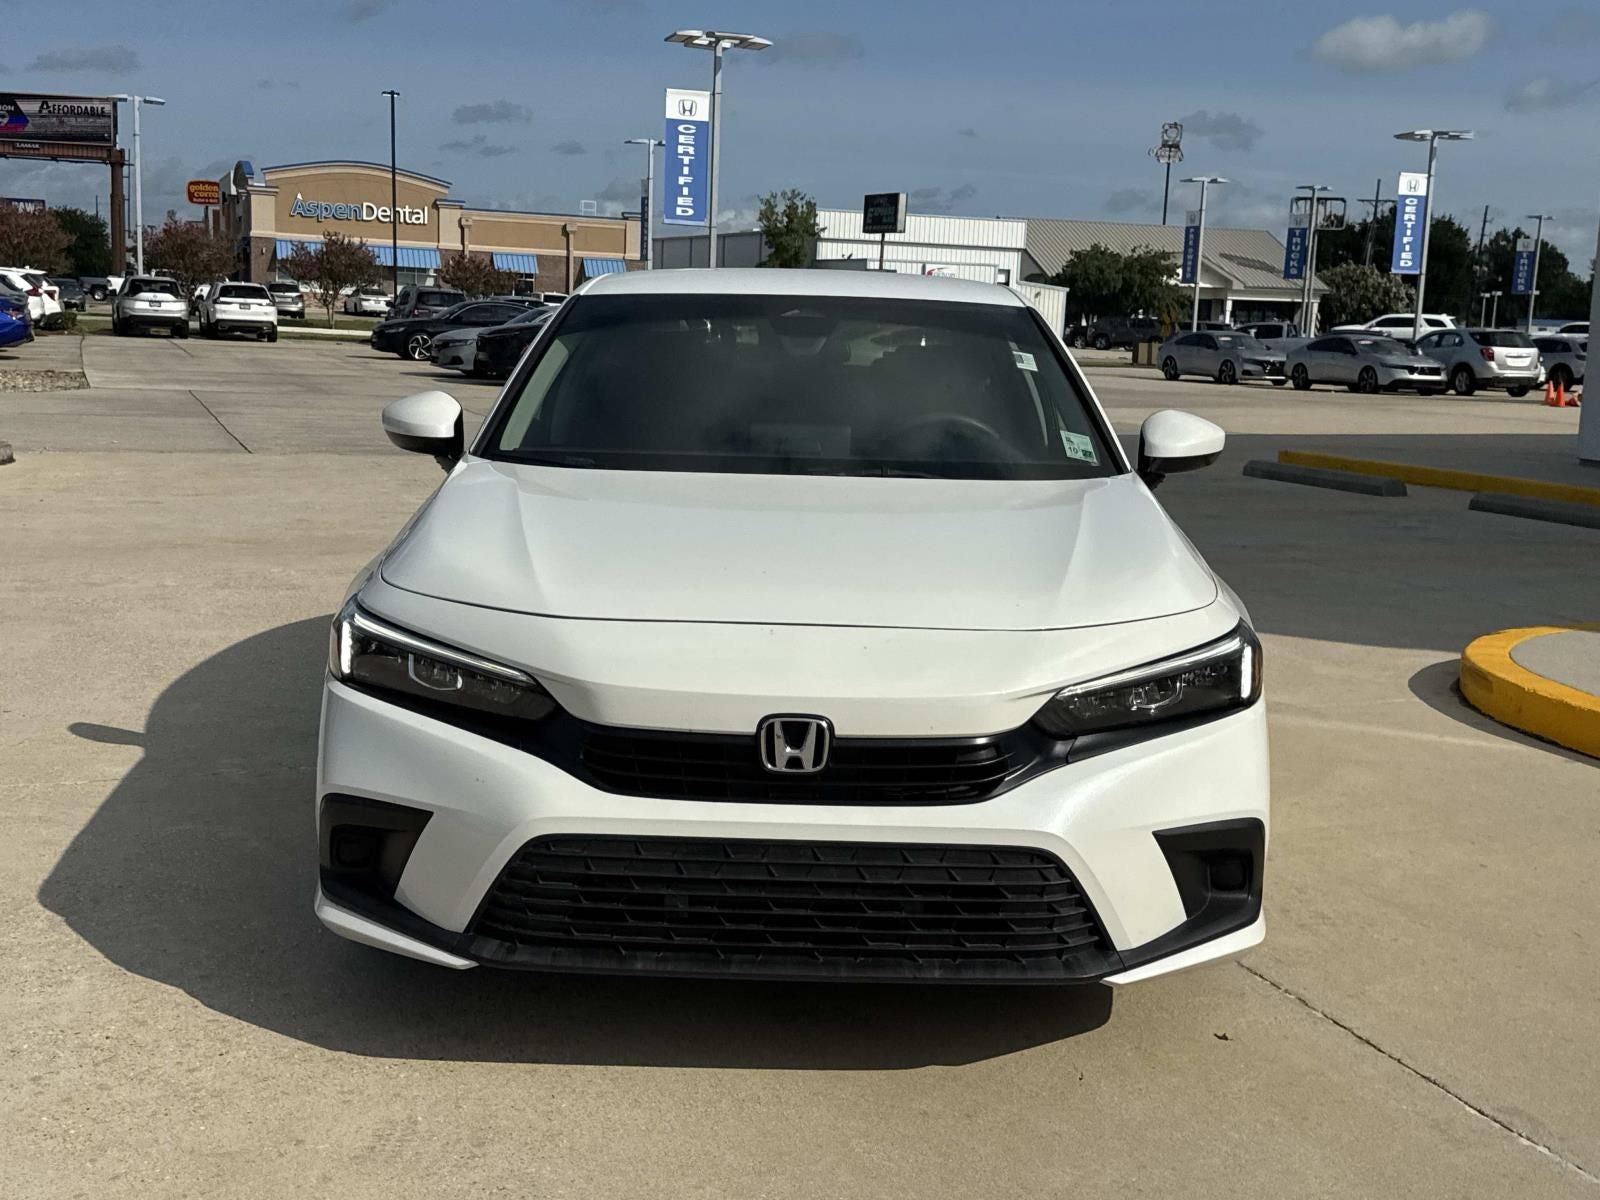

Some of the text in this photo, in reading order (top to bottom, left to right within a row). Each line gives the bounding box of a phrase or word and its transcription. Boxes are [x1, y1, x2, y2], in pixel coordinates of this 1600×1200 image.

[38, 101, 105, 117] AFFORDABLE
[189, 184, 218, 192] golden
[676, 124, 696, 216] CERTIFIED
[1290, 229, 1301, 274] TRUCKS
[1400, 198, 1418, 267] CERTIFIED
[1517, 252, 1528, 291] TRUCKS
